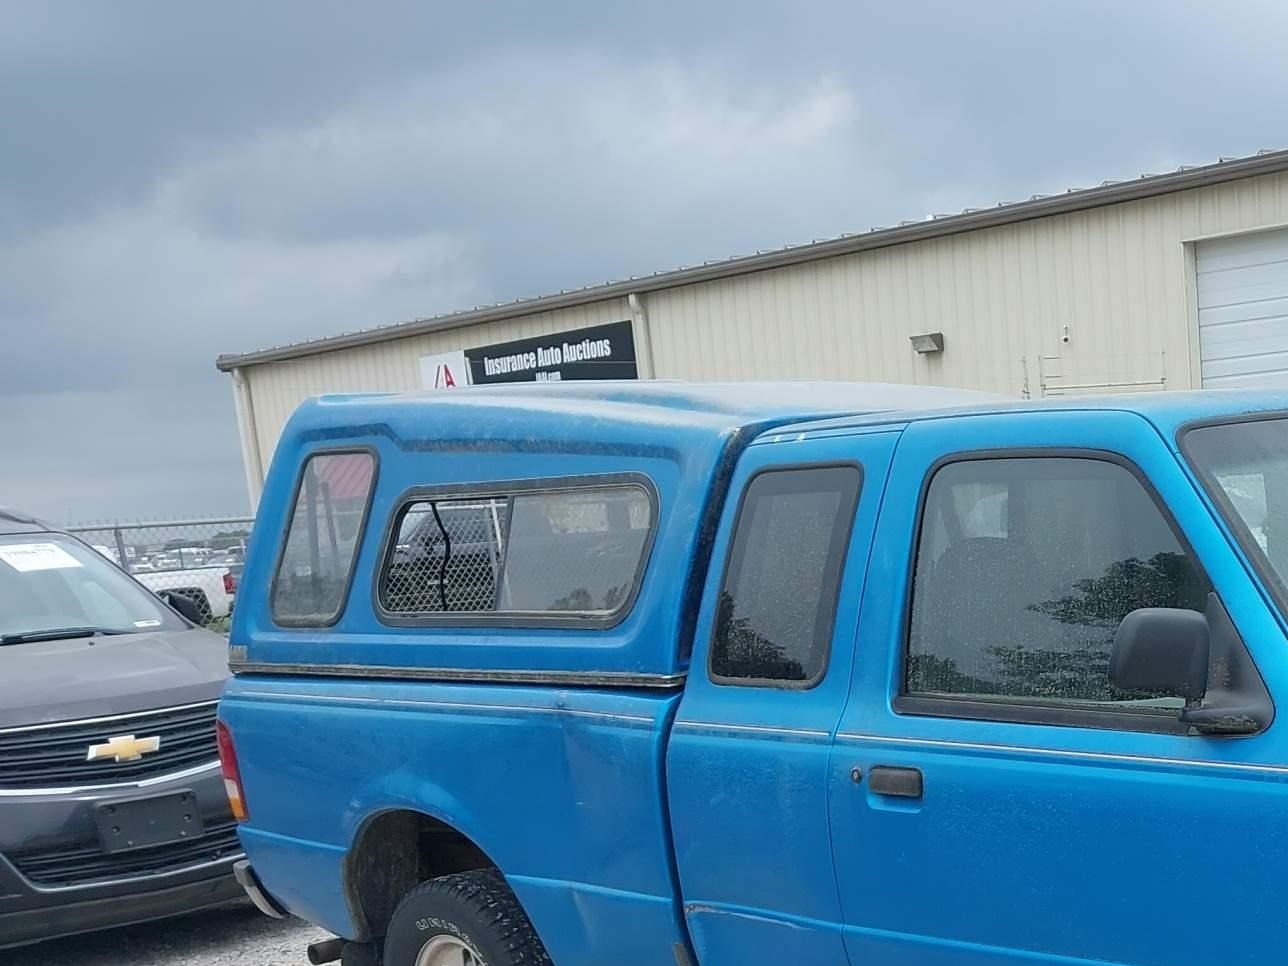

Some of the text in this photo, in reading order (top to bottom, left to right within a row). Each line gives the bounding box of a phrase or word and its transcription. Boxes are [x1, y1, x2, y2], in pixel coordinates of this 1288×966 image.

[484, 338, 612, 376] Insurance Auto Auctions
